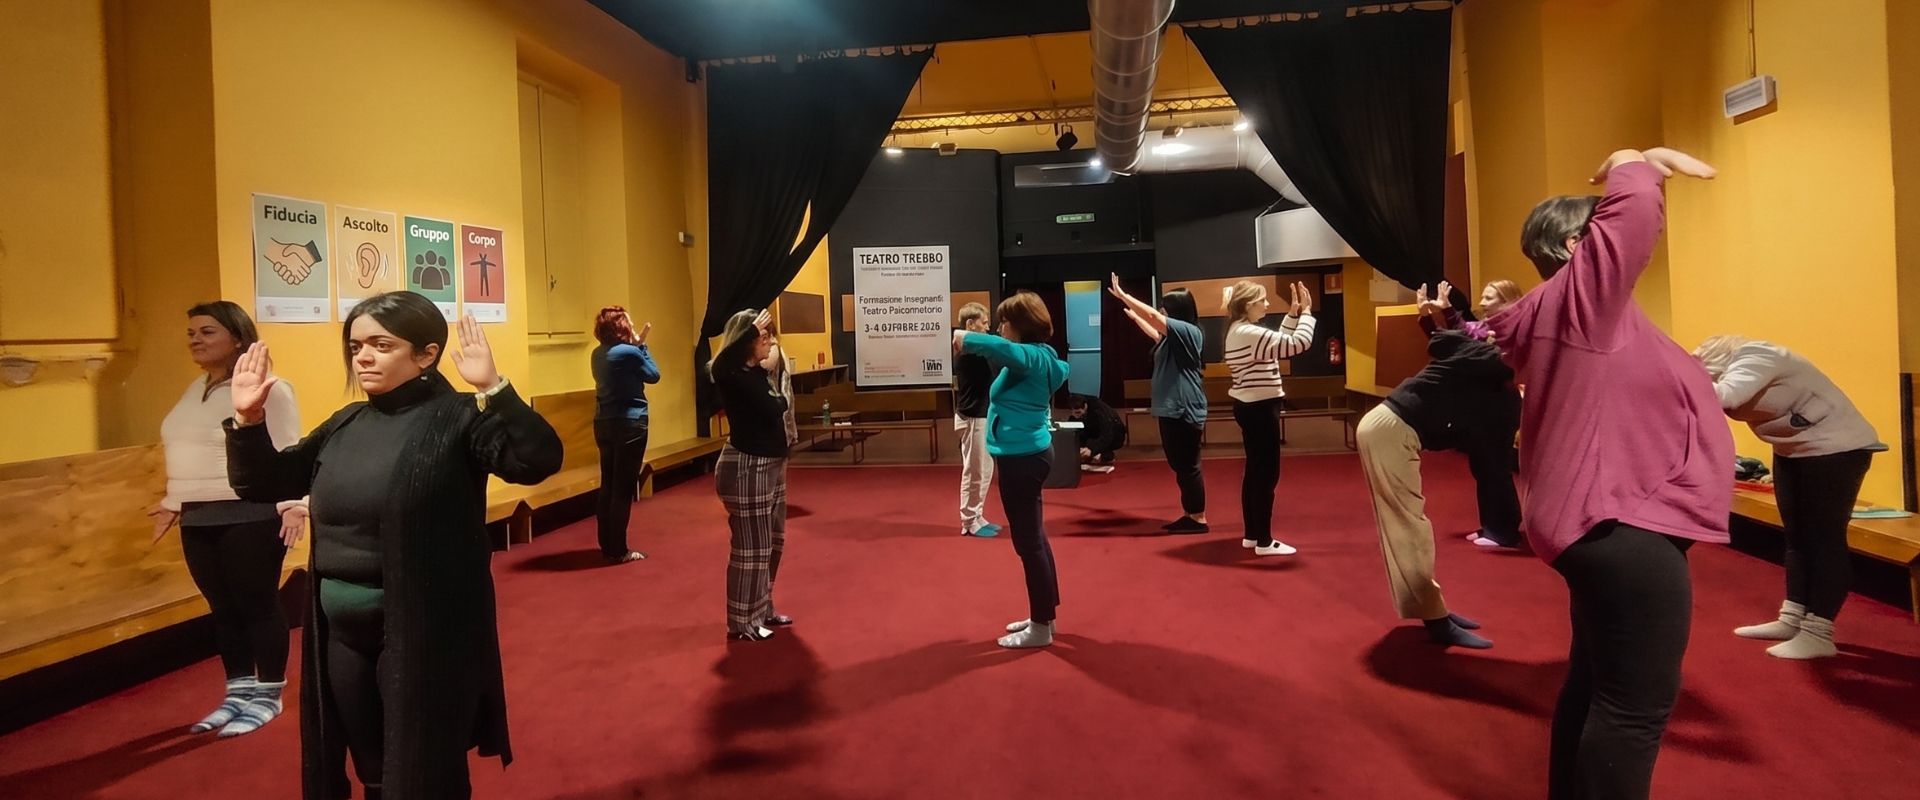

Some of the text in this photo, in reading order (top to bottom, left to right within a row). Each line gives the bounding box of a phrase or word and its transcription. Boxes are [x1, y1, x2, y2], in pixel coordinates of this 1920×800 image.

[264, 205, 317, 225] Fiducia
[343, 216, 389, 234] Ascolto
[410, 224, 450, 244] Gruppo
[468, 232, 497, 248] Corpo
[860, 253, 943, 264] TEATRO TREBBO
[862, 306, 887, 315] Teatro
[864, 323, 879, 333] 3-4
[920, 322, 941, 331] 2026
